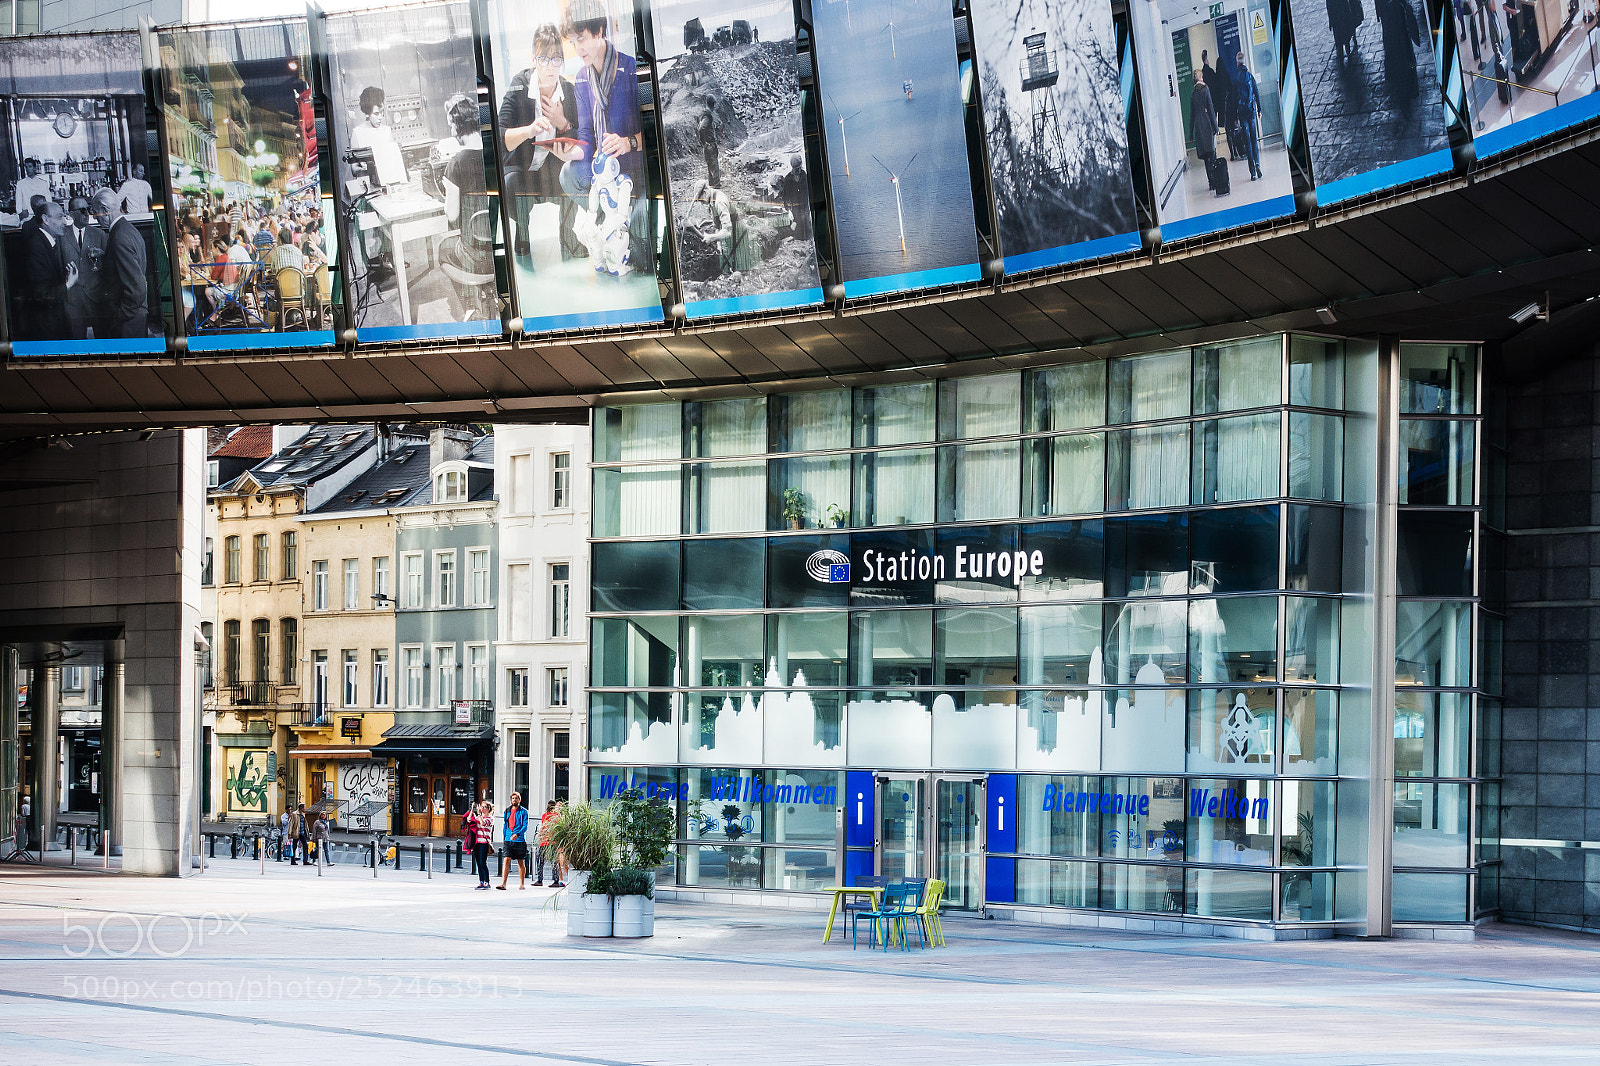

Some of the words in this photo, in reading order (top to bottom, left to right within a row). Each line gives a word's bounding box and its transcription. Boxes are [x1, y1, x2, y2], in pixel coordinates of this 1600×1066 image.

[862, 549, 945, 582] Station
[955, 545, 1044, 586] Europe
[600, 774, 690, 801] Welcome
[710, 776, 837, 806] Willkommen
[1042, 783, 1149, 816] Bienvenue
[1190, 788, 1268, 820] Welkom
